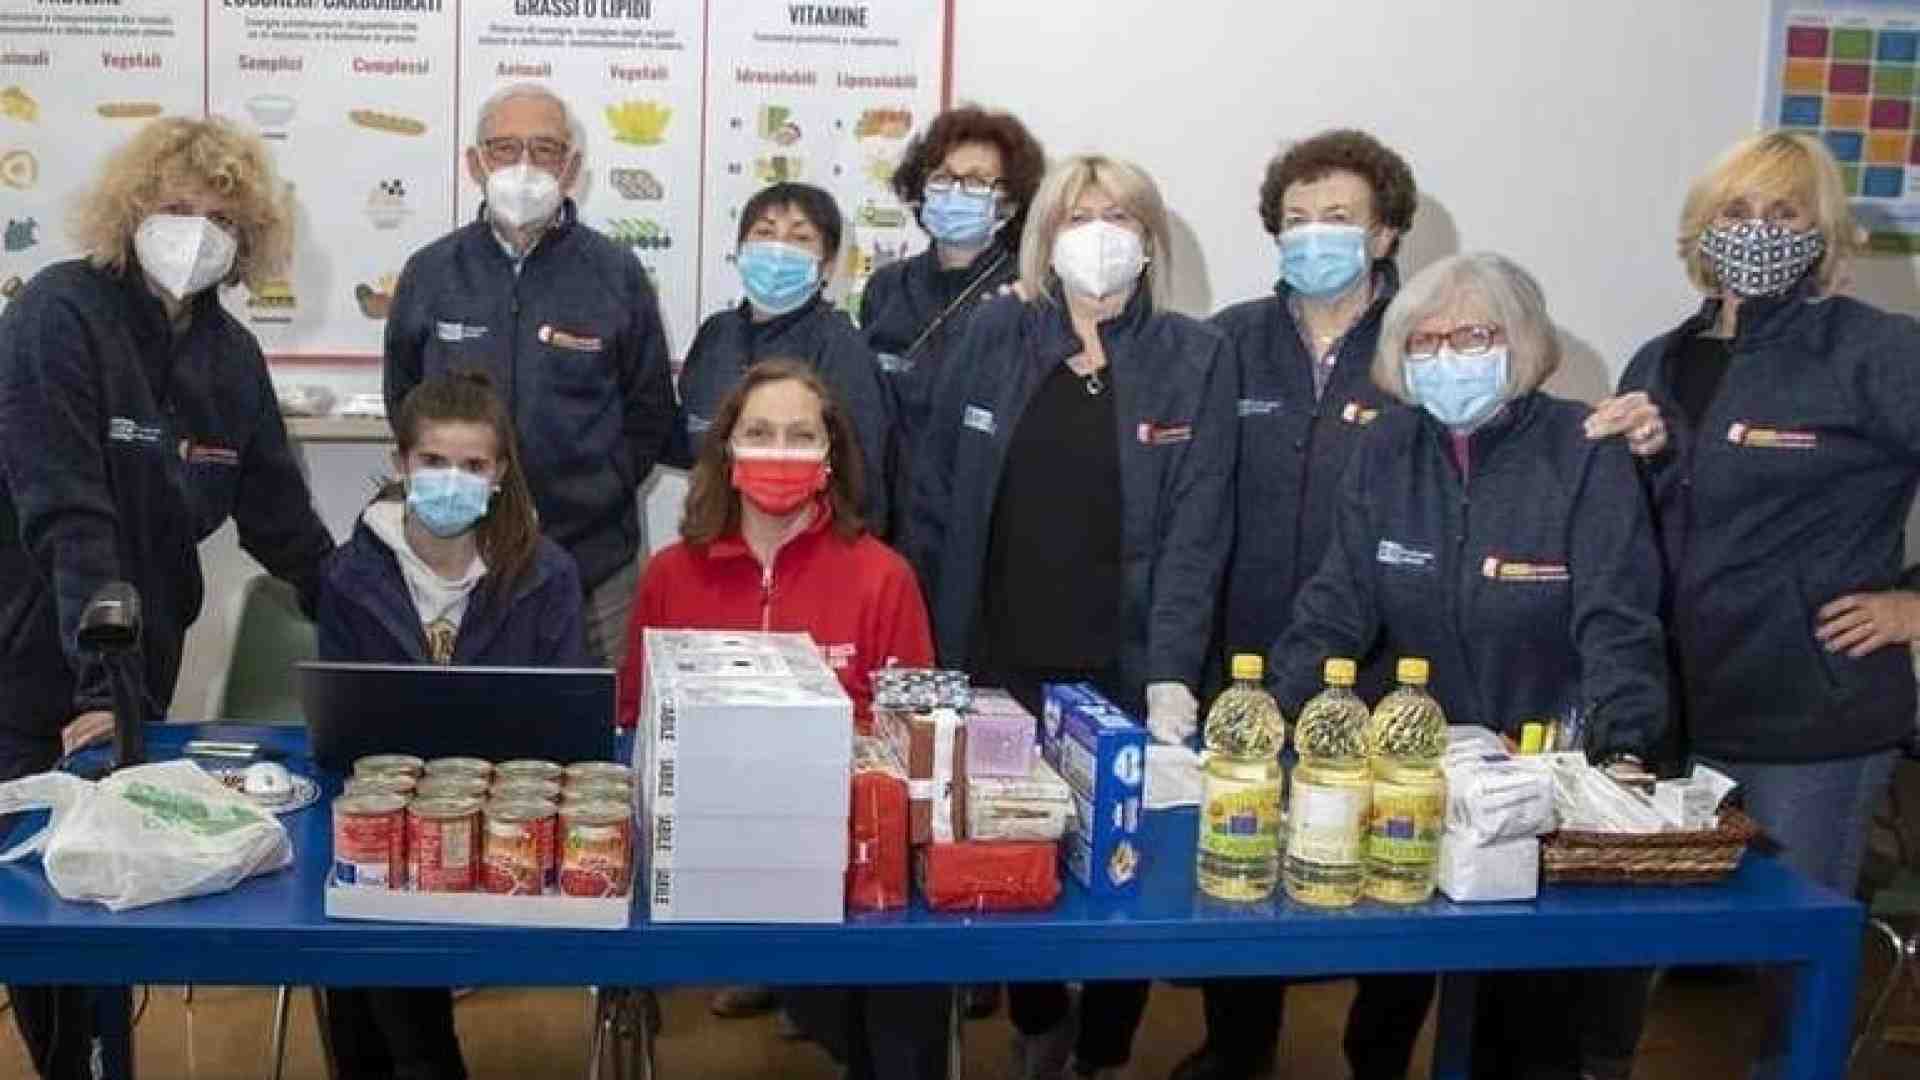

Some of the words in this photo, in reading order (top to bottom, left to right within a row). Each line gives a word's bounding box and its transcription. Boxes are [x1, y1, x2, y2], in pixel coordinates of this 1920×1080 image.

[514, 0, 580, 18] GRASSI
[584, 0, 597, 18] O
[601, 0, 652, 20] LIPIDI
[788, 5, 869, 28] VITAMINE
[102, 53, 162, 69] Vegetali
[239, 55, 303, 73] Semplici
[353, 56, 429, 75] Complessi
[609, 63, 671, 81] Vegetali
